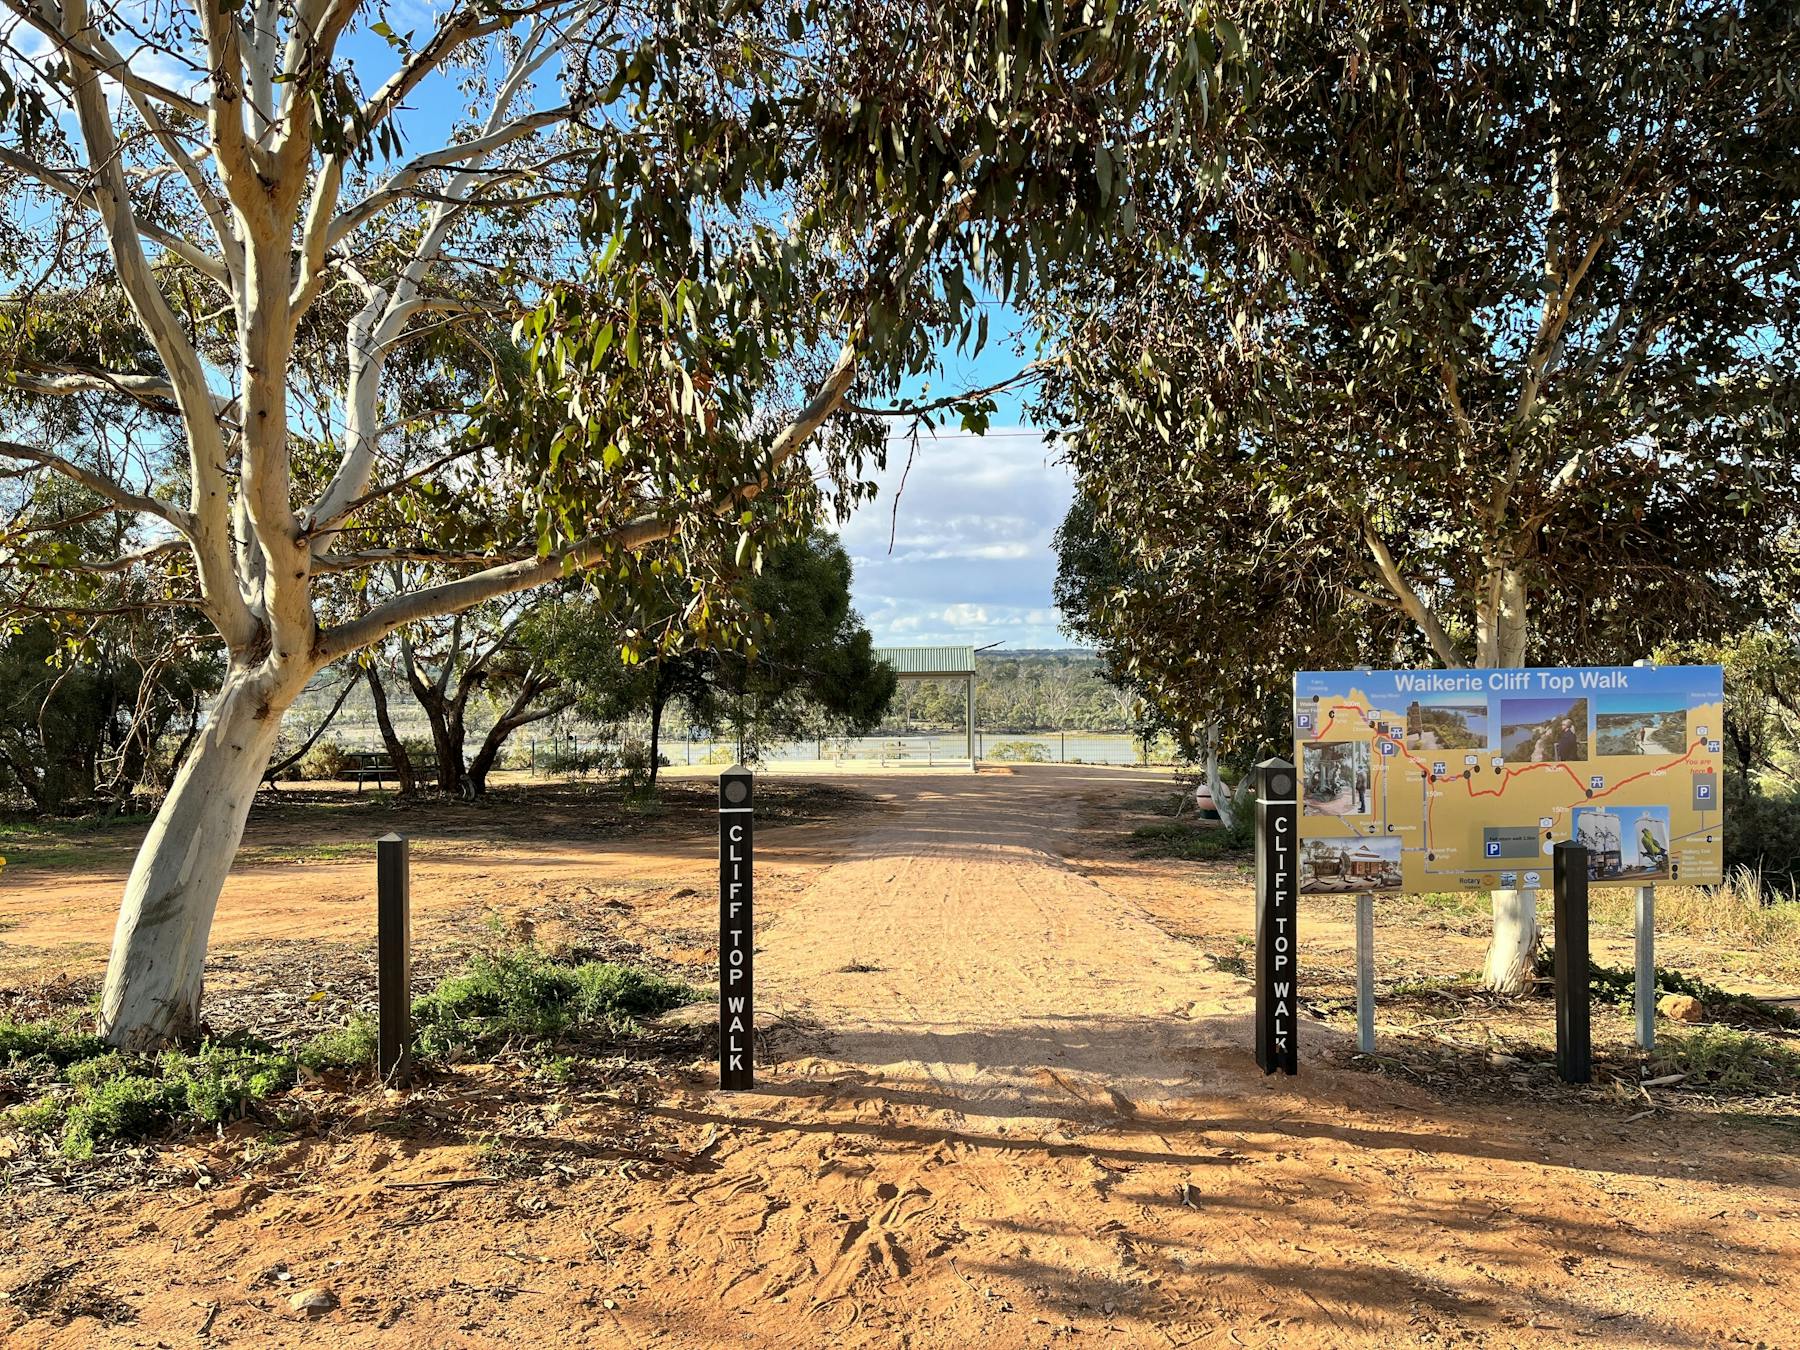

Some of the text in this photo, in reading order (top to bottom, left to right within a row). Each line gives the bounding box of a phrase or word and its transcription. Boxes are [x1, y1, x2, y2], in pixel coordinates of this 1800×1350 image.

[1395, 671, 1628, 693] Waikerie Cliff Top Walk
[1274, 816, 1289, 1053] CLIFF TOP WALK
[1459, 877, 1480, 885] Rotary
[728, 825, 745, 1071] CLIFF TOP WALK
